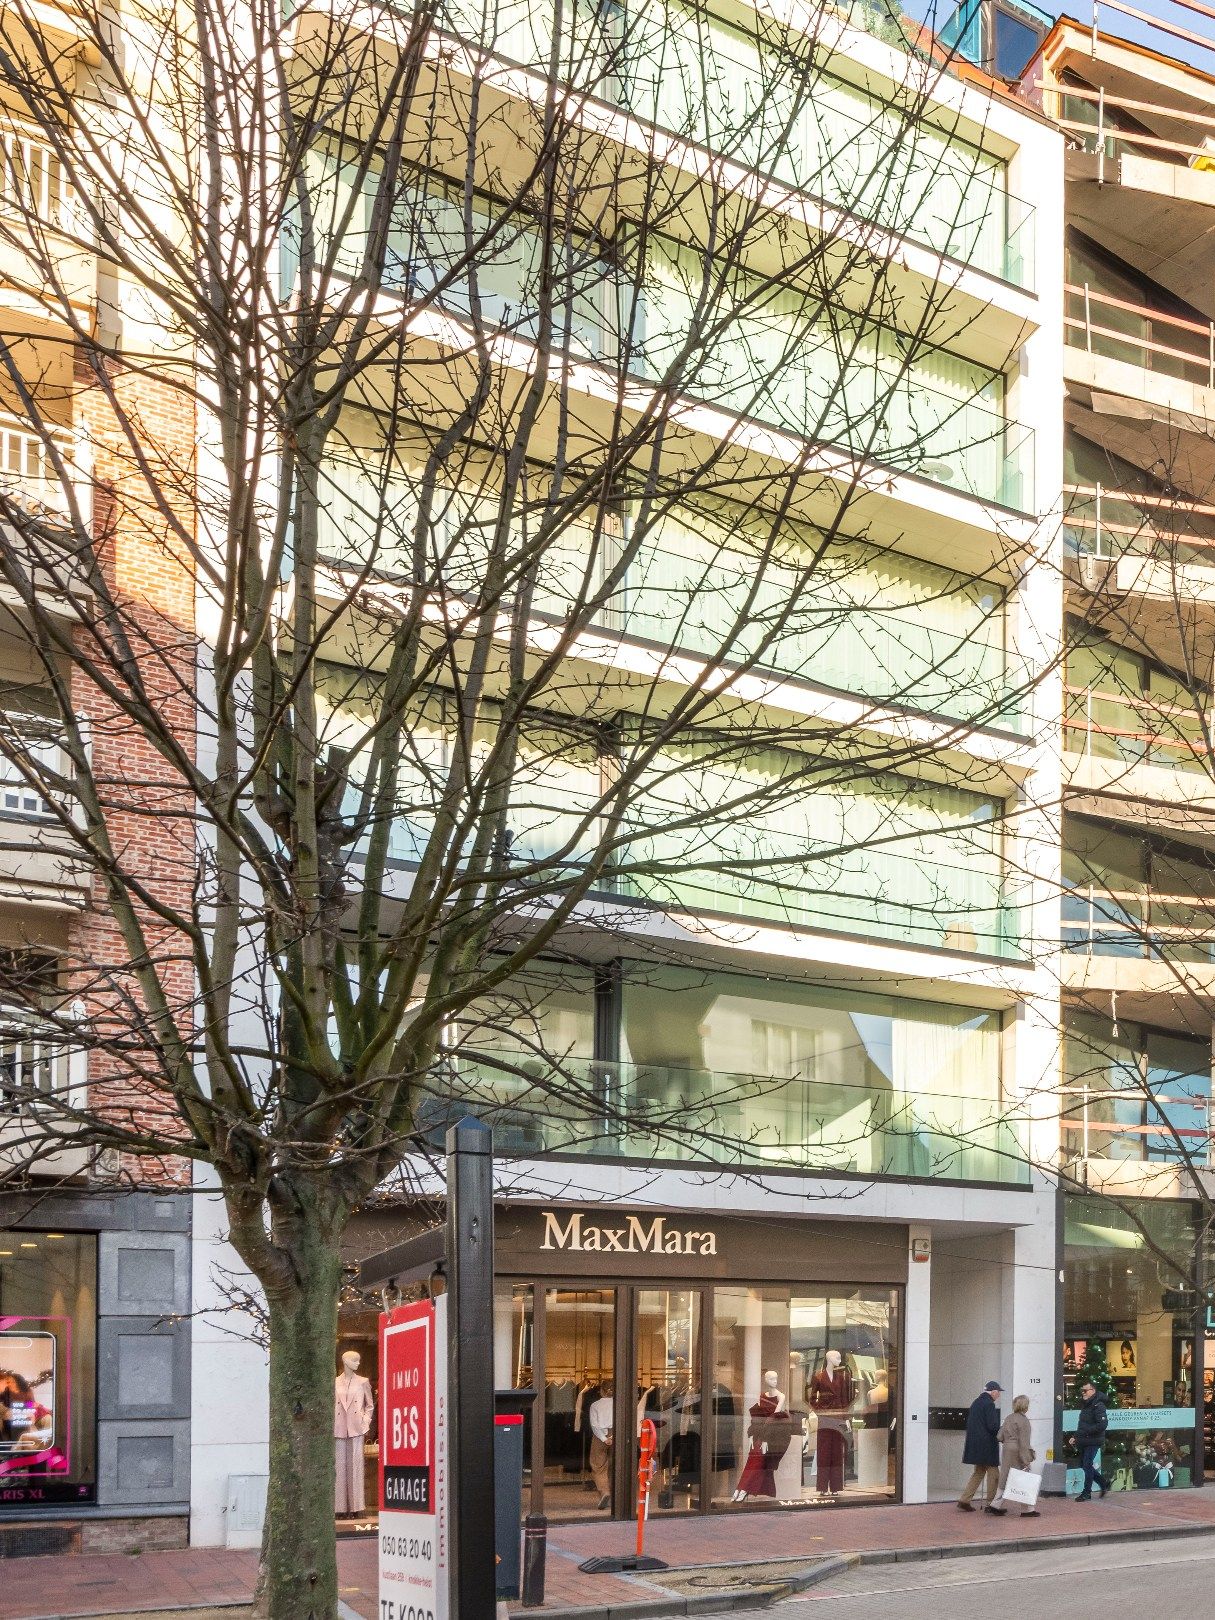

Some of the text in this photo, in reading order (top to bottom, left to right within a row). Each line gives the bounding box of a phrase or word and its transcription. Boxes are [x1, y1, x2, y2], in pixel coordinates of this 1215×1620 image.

[539, 1212, 717, 1255] MaxMara
[392, 1367, 419, 1390] IMMO
[386, 1477, 427, 1502] GARAGE
[382, 1536, 432, 1561] 050 63 20 40
[381, 1600, 394, 1620] TE
